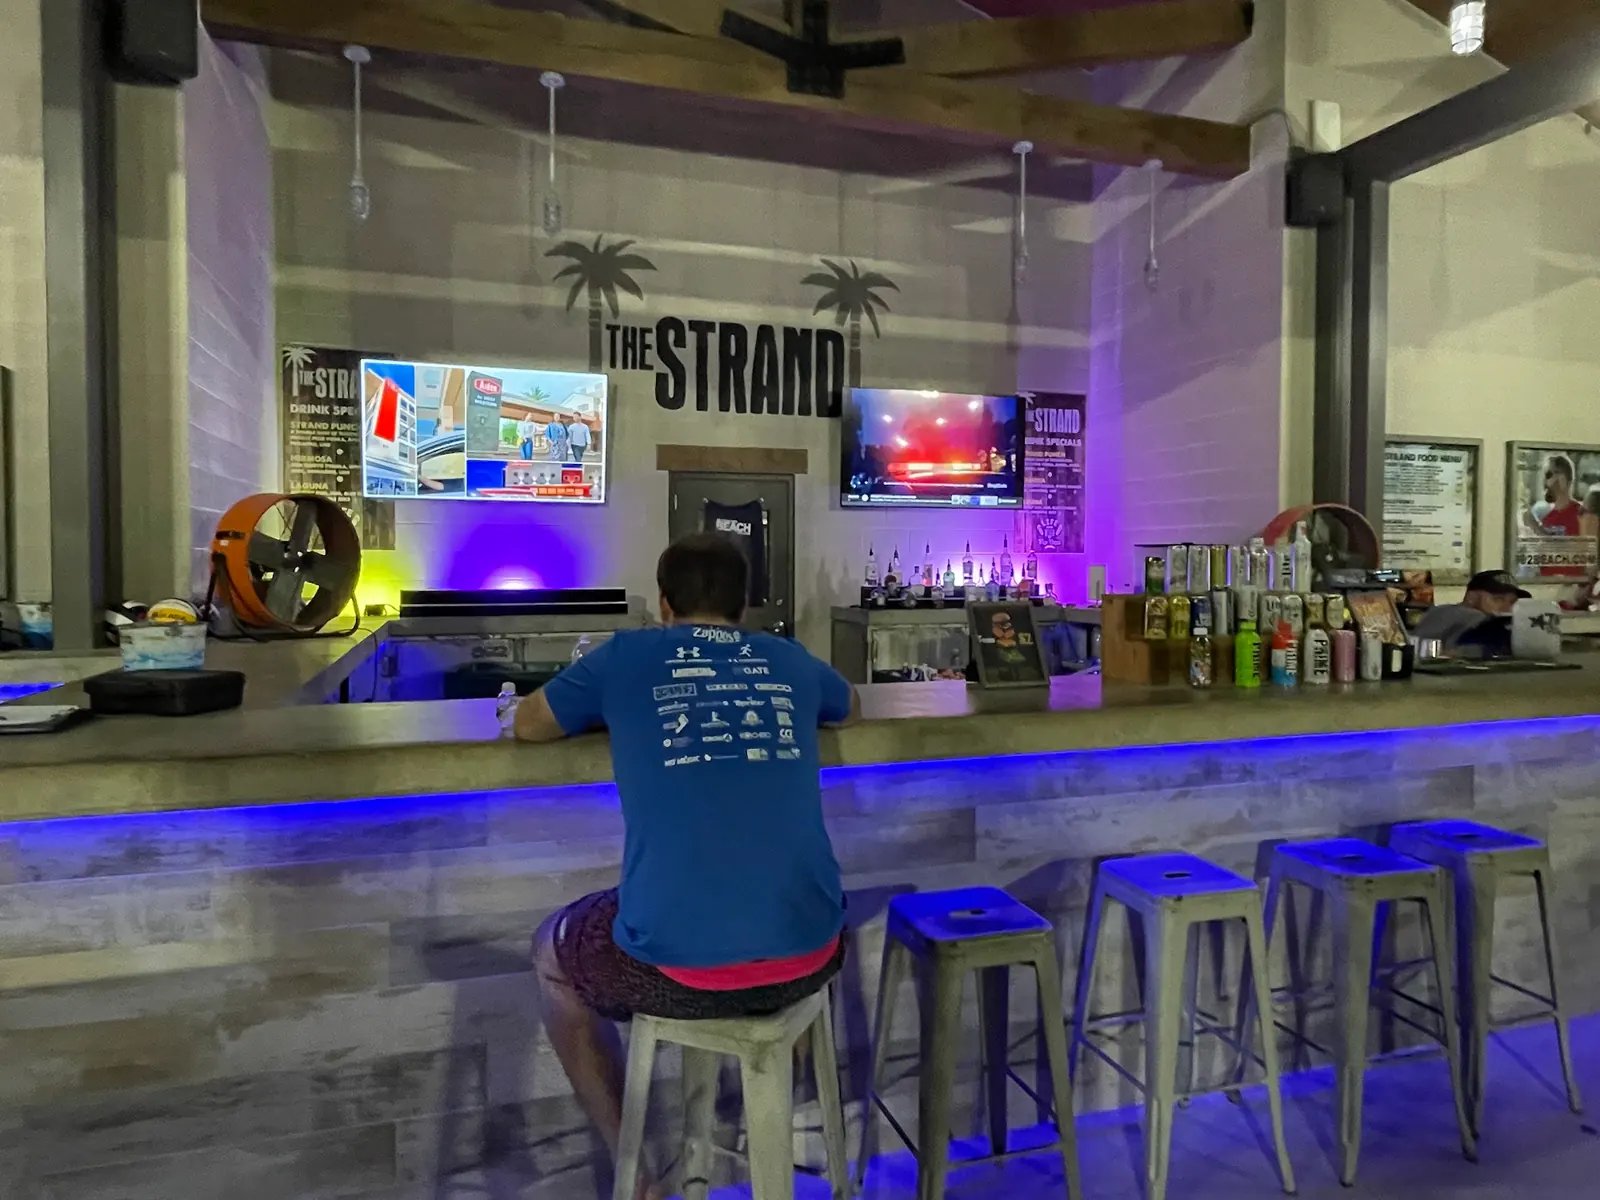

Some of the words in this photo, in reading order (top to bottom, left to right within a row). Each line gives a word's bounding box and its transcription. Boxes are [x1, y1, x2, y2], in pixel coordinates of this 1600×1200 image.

[606, 323, 654, 370] THE
[655, 316, 844, 418] STRAND
[300, 370, 315, 386] THE
[290, 403, 330, 415] DRINK
[290, 421, 329, 430] STRAND
[1035, 407, 1080, 434] STRAND
[1045, 437, 1082, 447] SPECIALS
[1417, 454, 1439, 462] FOOD
[290, 482, 329, 490] LAGUNA
[716, 518, 752, 535] BEACH
[692, 627, 734, 643] Zappos
